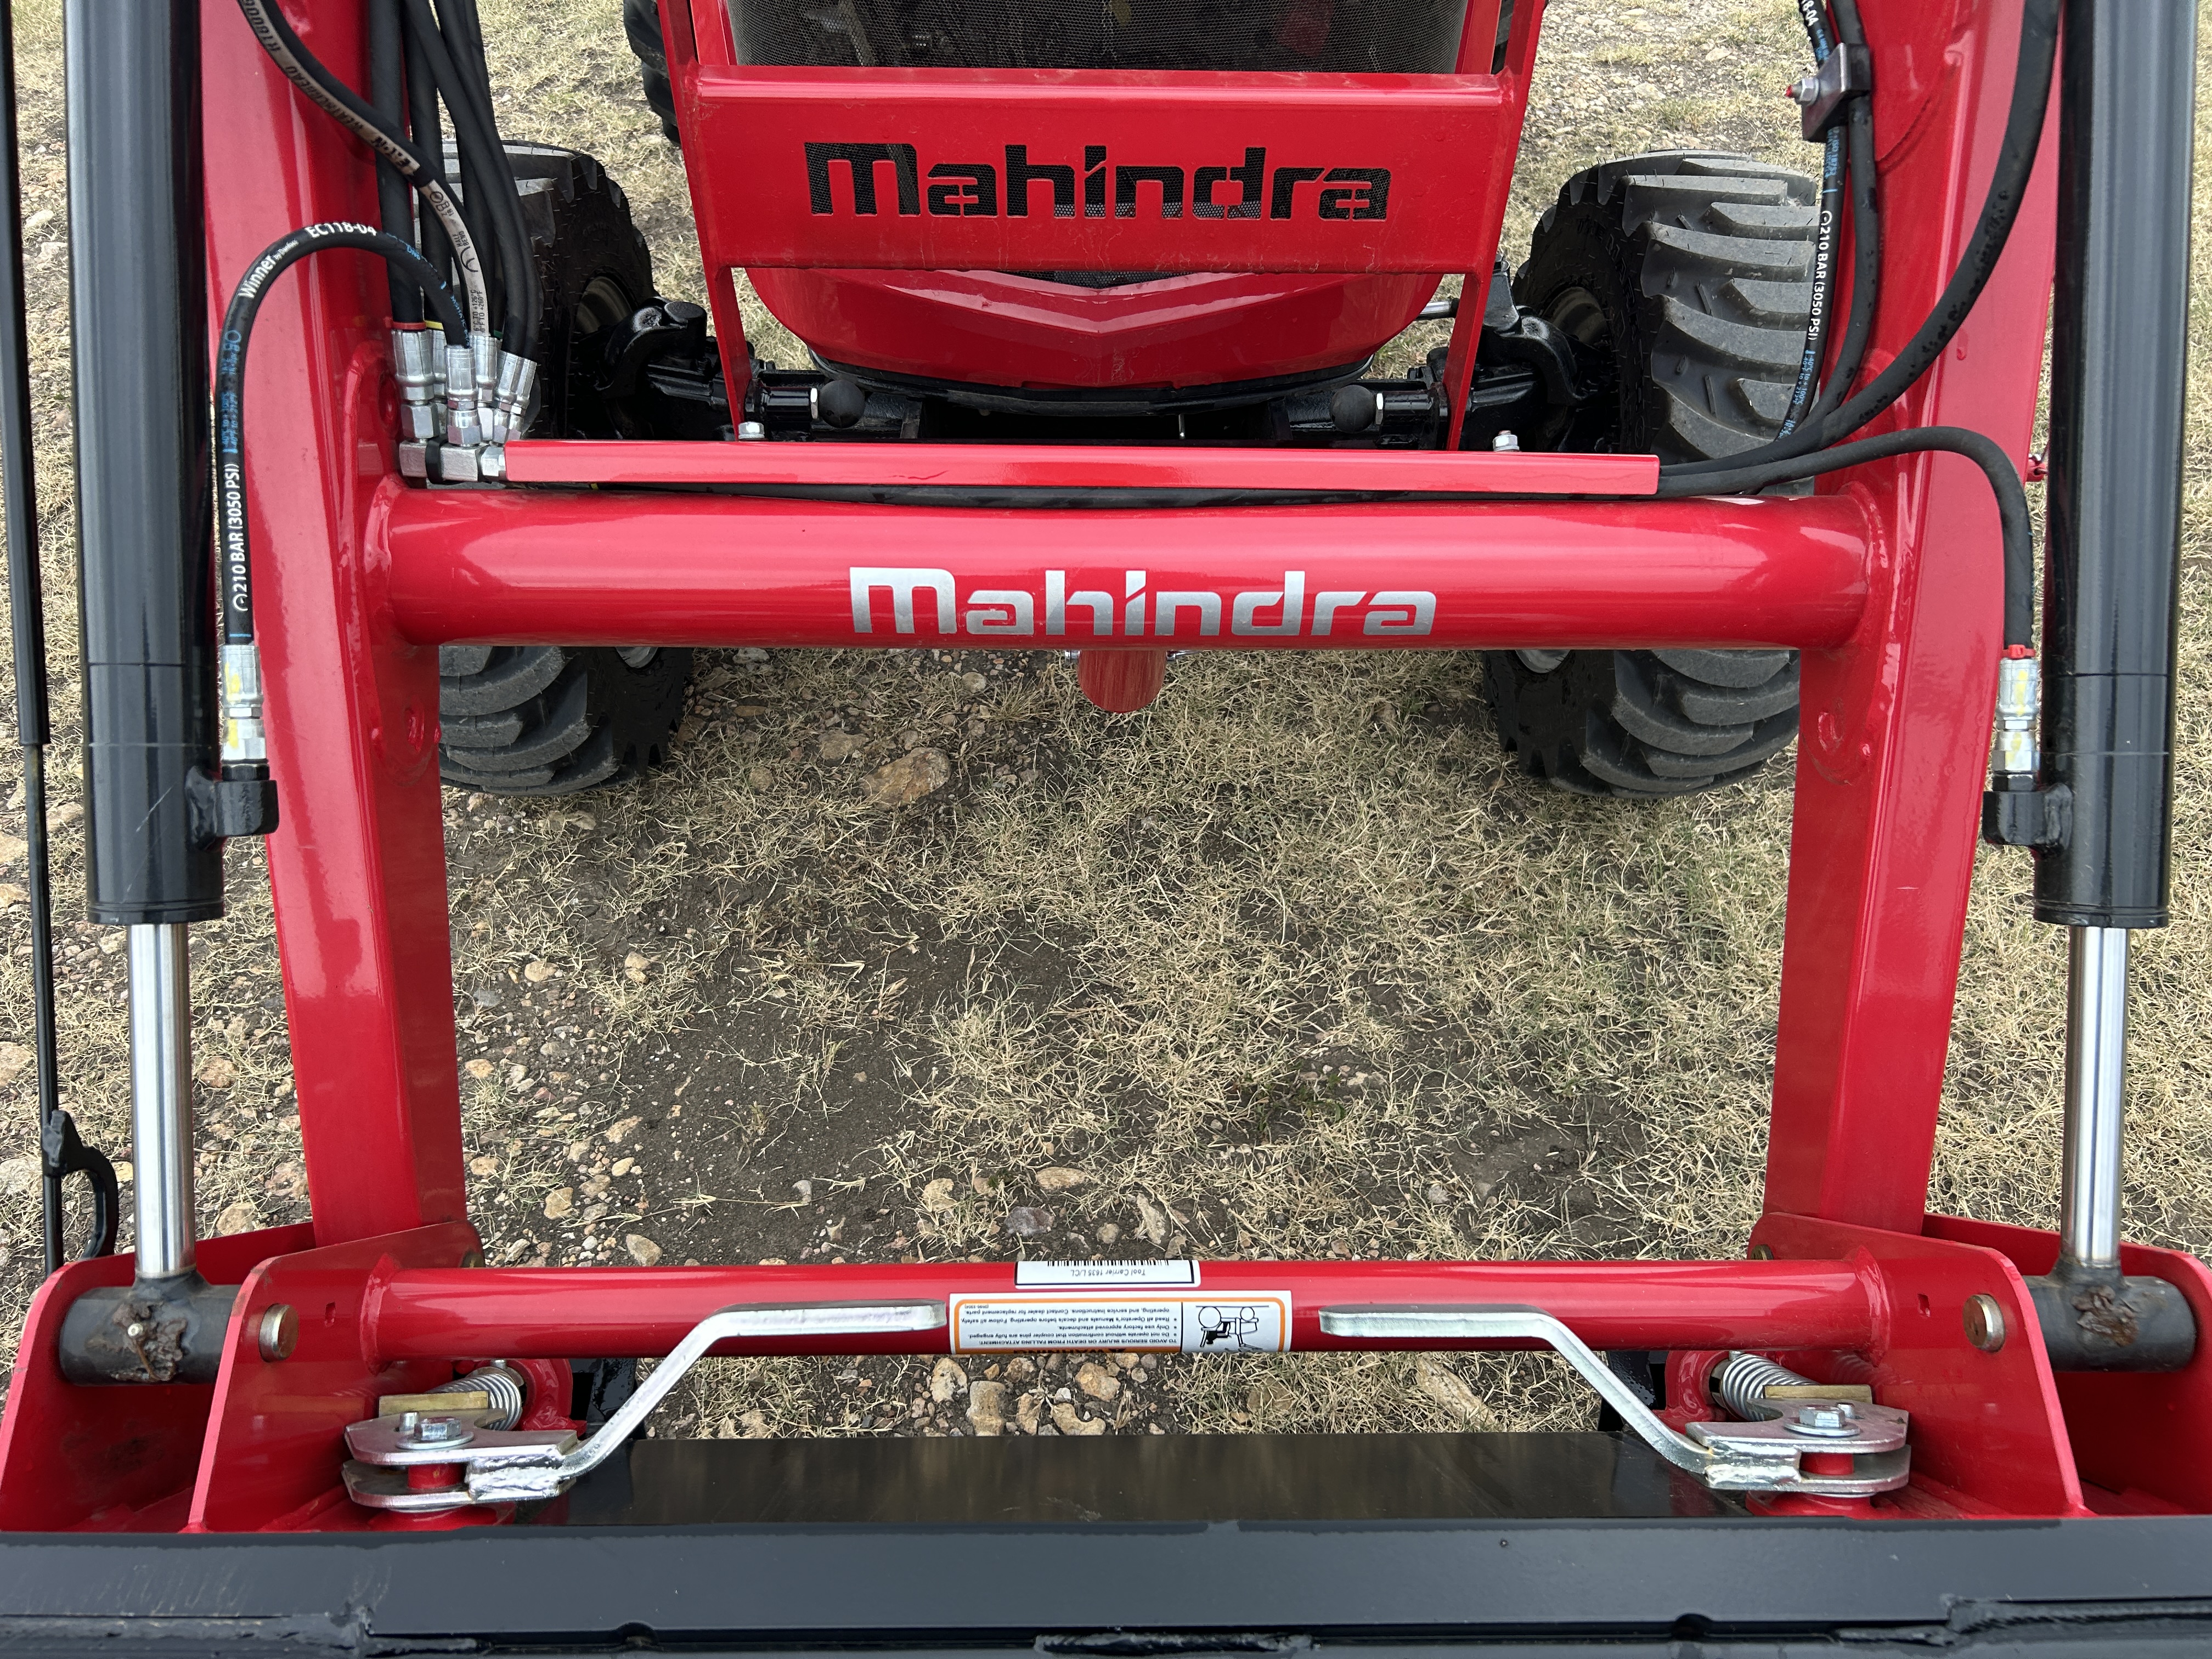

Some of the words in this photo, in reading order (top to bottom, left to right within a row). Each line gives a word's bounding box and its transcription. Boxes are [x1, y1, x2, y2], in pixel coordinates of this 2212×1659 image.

[804, 143, 1392, 221] Mahindra
[304, 221, 377, 239] EC118-04
[1818, 226, 1831, 251] 210
[238, 253, 277, 299] Winner
[1815, 253, 1829, 279] BAR
[1812, 282, 1826, 315] (3050
[1808, 318, 1821, 341] PSI)
[223, 462, 240, 489] PSI)
[227, 491, 243, 529] (3050
[229, 532, 245, 562] BAR
[233, 564, 247, 593] 210
[849, 567, 1437, 636] Mahindra
